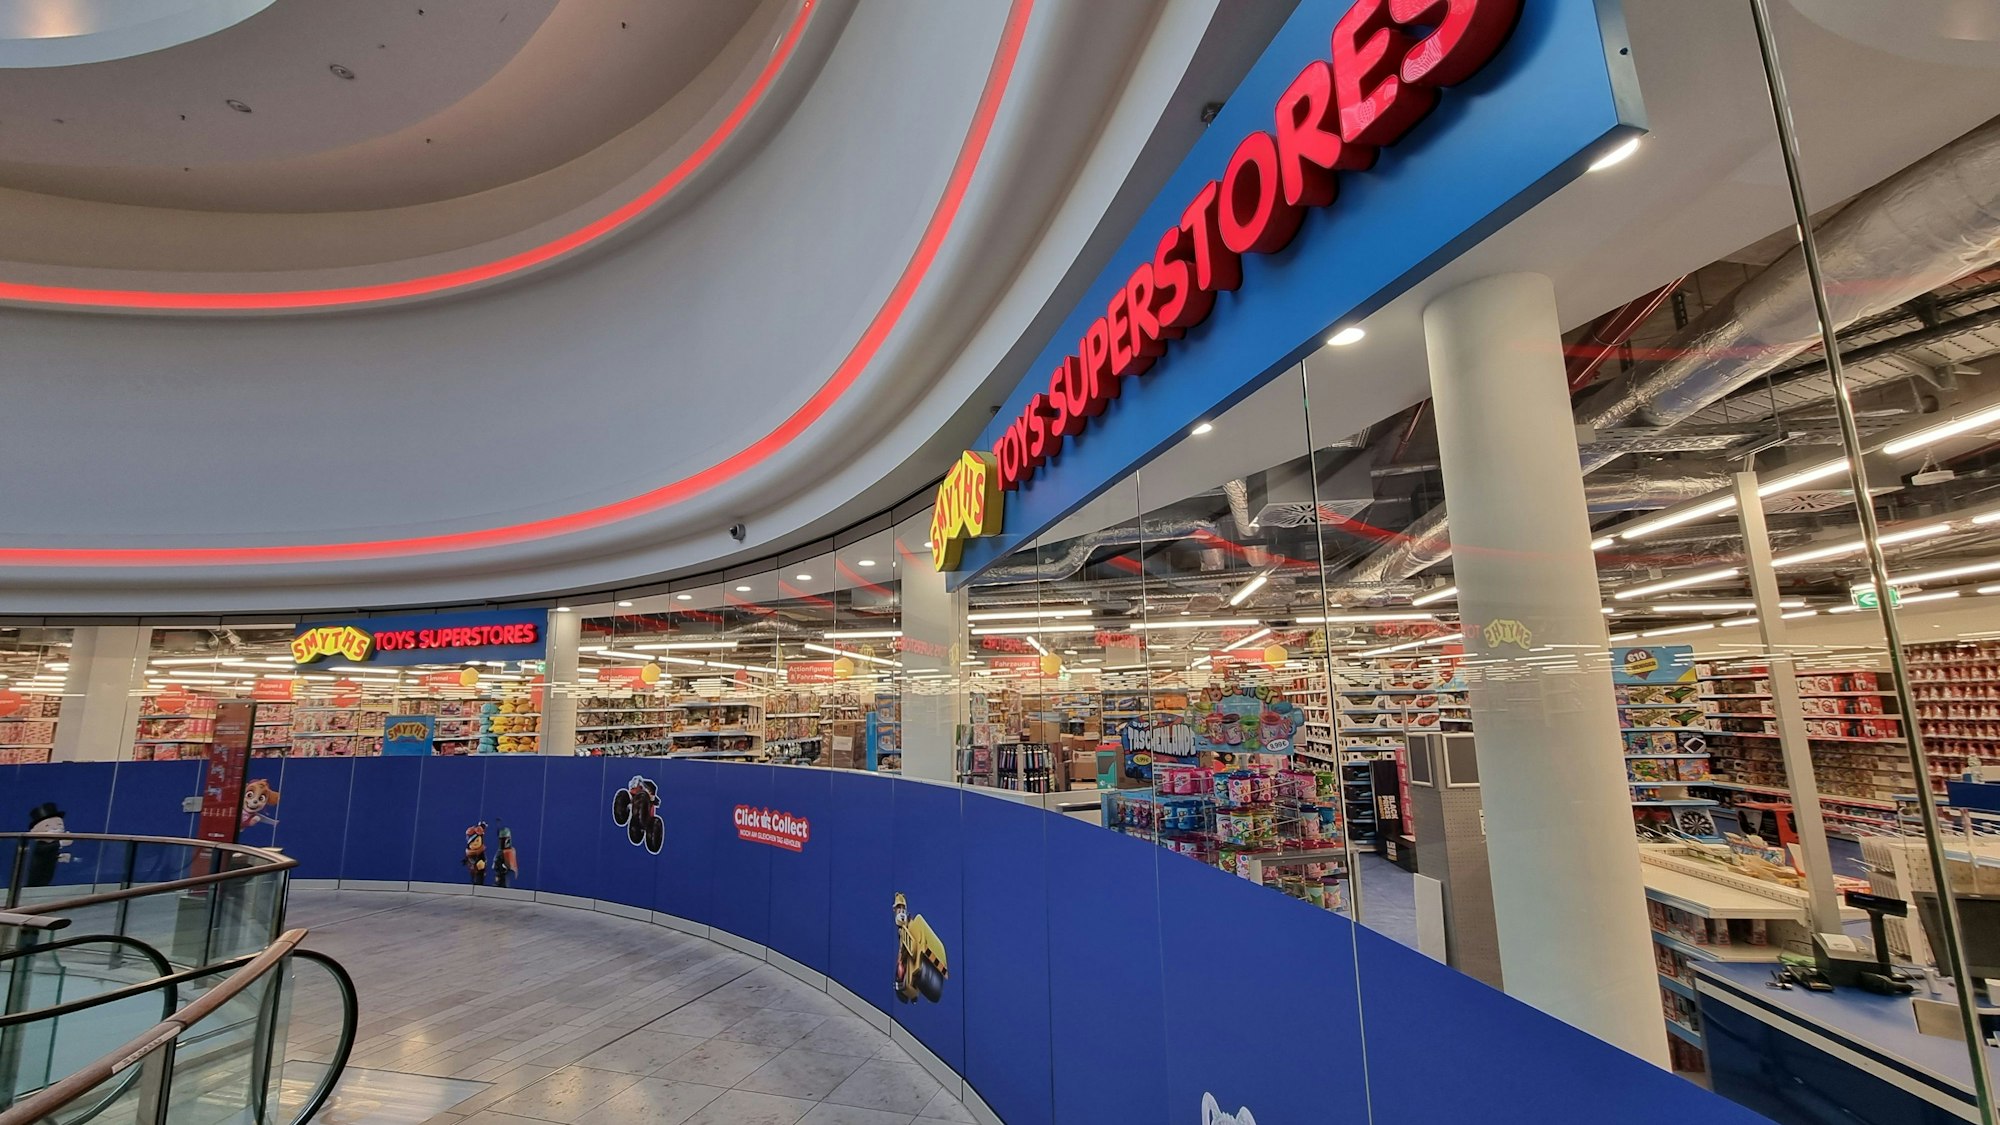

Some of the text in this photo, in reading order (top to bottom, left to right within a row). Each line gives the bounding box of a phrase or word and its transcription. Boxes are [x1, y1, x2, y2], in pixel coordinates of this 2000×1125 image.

[931, 0, 1484, 566] SMYTHS TOYS SUPERSTORES
[293, 624, 537, 661] SMYTHS TOYS SUPERSTORES
[788, 665, 833, 673] Actionfiguren
[387, 723, 429, 741] SMYTHS
[734, 808, 808, 838] Click Collect
